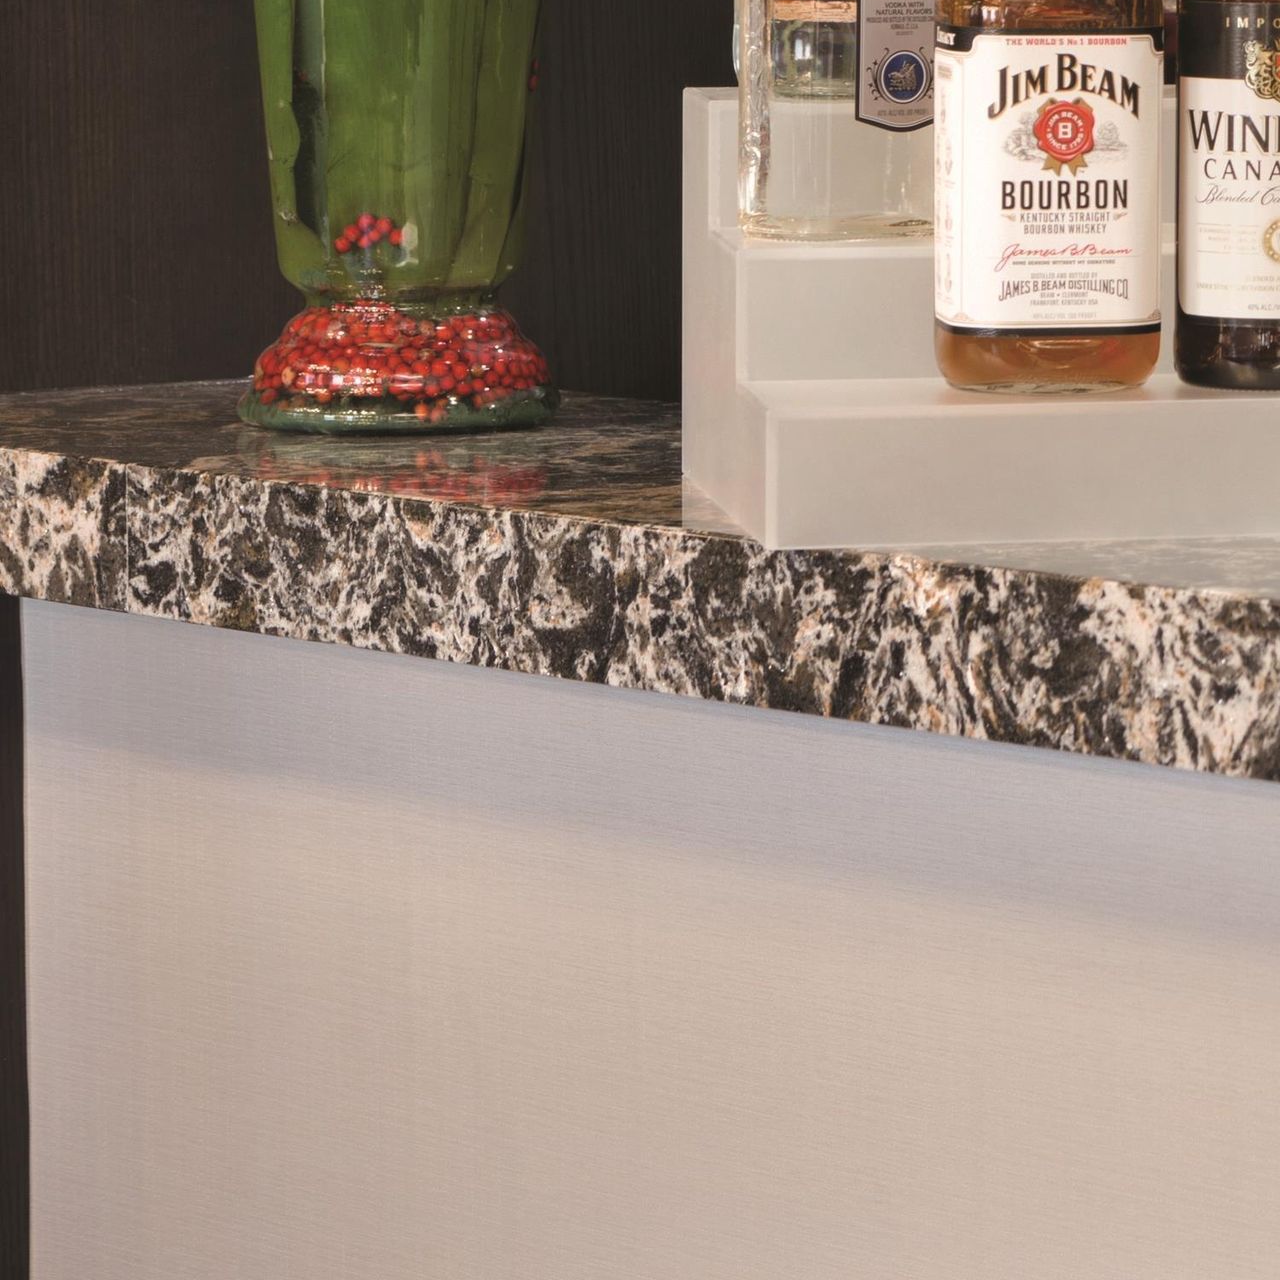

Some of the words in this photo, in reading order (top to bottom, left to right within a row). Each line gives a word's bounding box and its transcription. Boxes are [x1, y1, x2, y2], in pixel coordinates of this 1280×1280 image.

[987, 64, 1050, 119] JIM
[1055, 52, 1142, 120] BEAM
[1058, 122, 1072, 138] B
[1001, 179, 1128, 210] BOURBON
[1196, 183, 1260, 205] Blended
[1019, 212, 1066, 223] KENTUCKY
[1068, 211, 1111, 222] STRAIGHT
[1023, 224, 1066, 235] BOURBON
[1068, 223, 1107, 234] WHISKEY
[994, 243, 1058, 273] James
[1080, 243, 1133, 256] Beam
[998, 281, 1031, 302] JAMES
[1041, 280, 1066, 292] BEAM
[1068, 279, 1115, 295] DISTILLING
